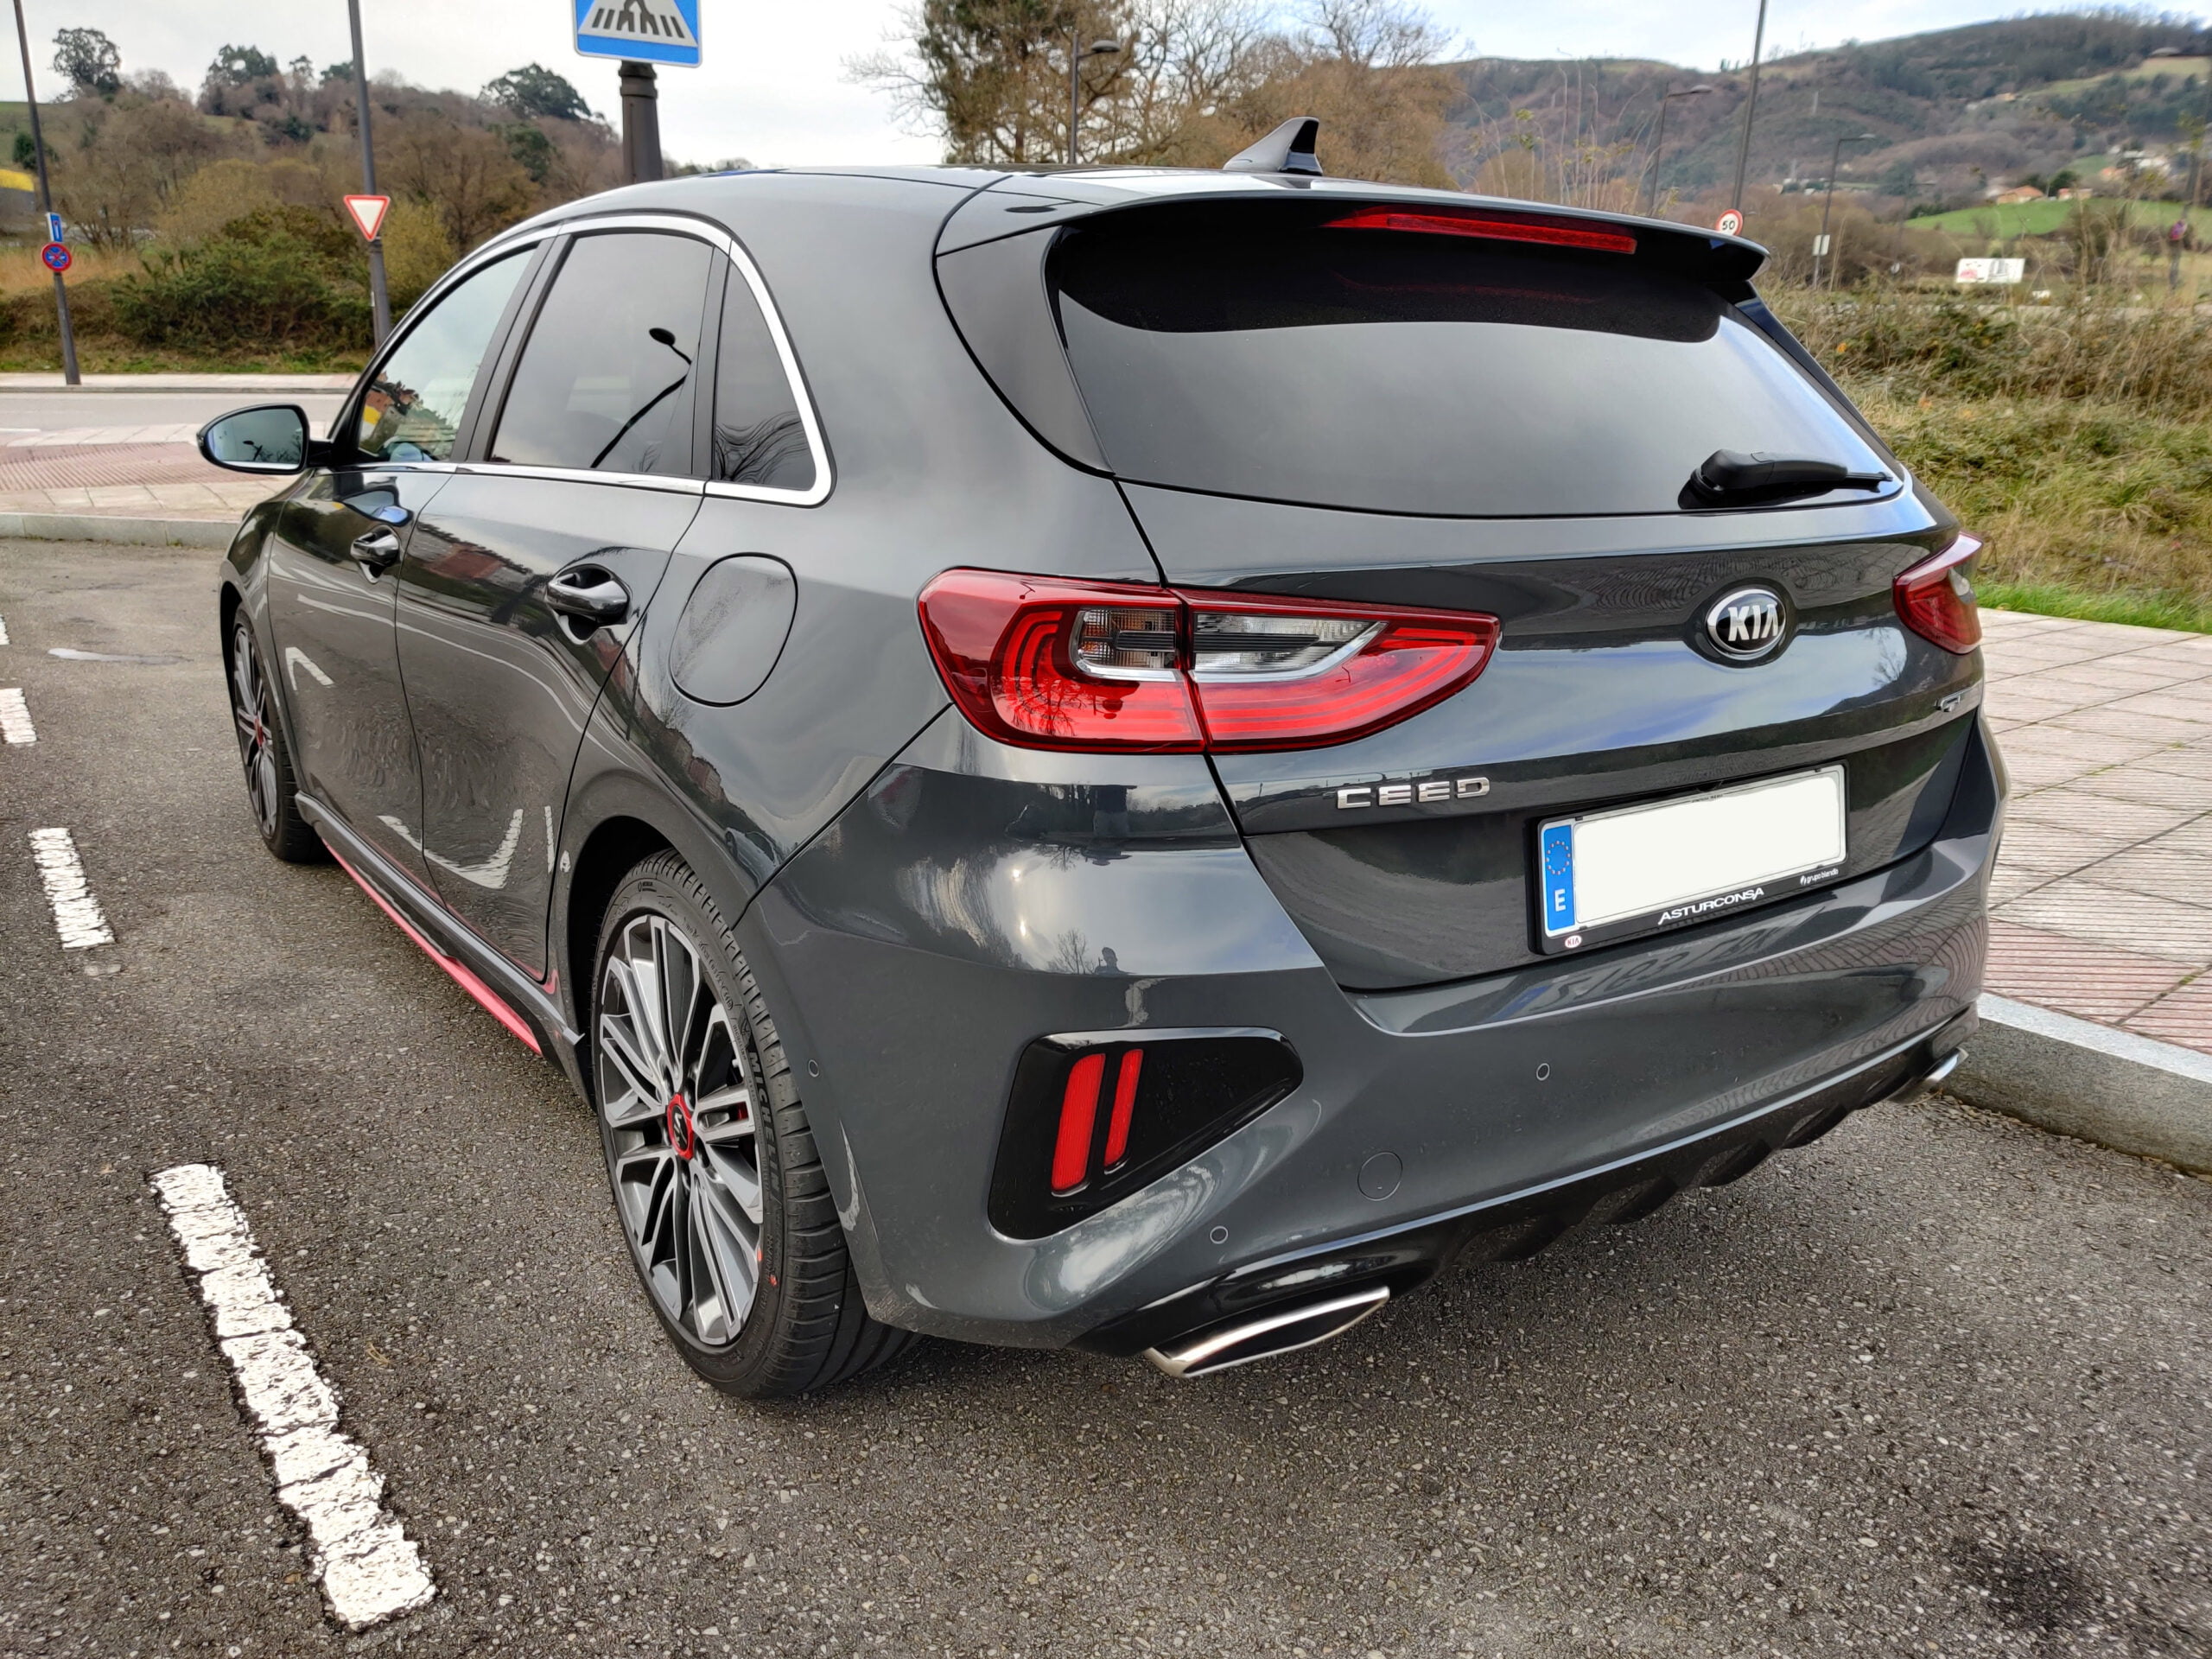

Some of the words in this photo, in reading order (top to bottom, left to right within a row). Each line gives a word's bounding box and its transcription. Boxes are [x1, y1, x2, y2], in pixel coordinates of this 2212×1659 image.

[1722, 219, 1735, 231] 50
[1727, 603, 1780, 642] KIA
[1337, 776, 1491, 810] CEED
[1554, 888, 1567, 912] E
[1657, 887, 1764, 925] ASTURCONSA
[748, 1051, 780, 1192] MICHELIN
